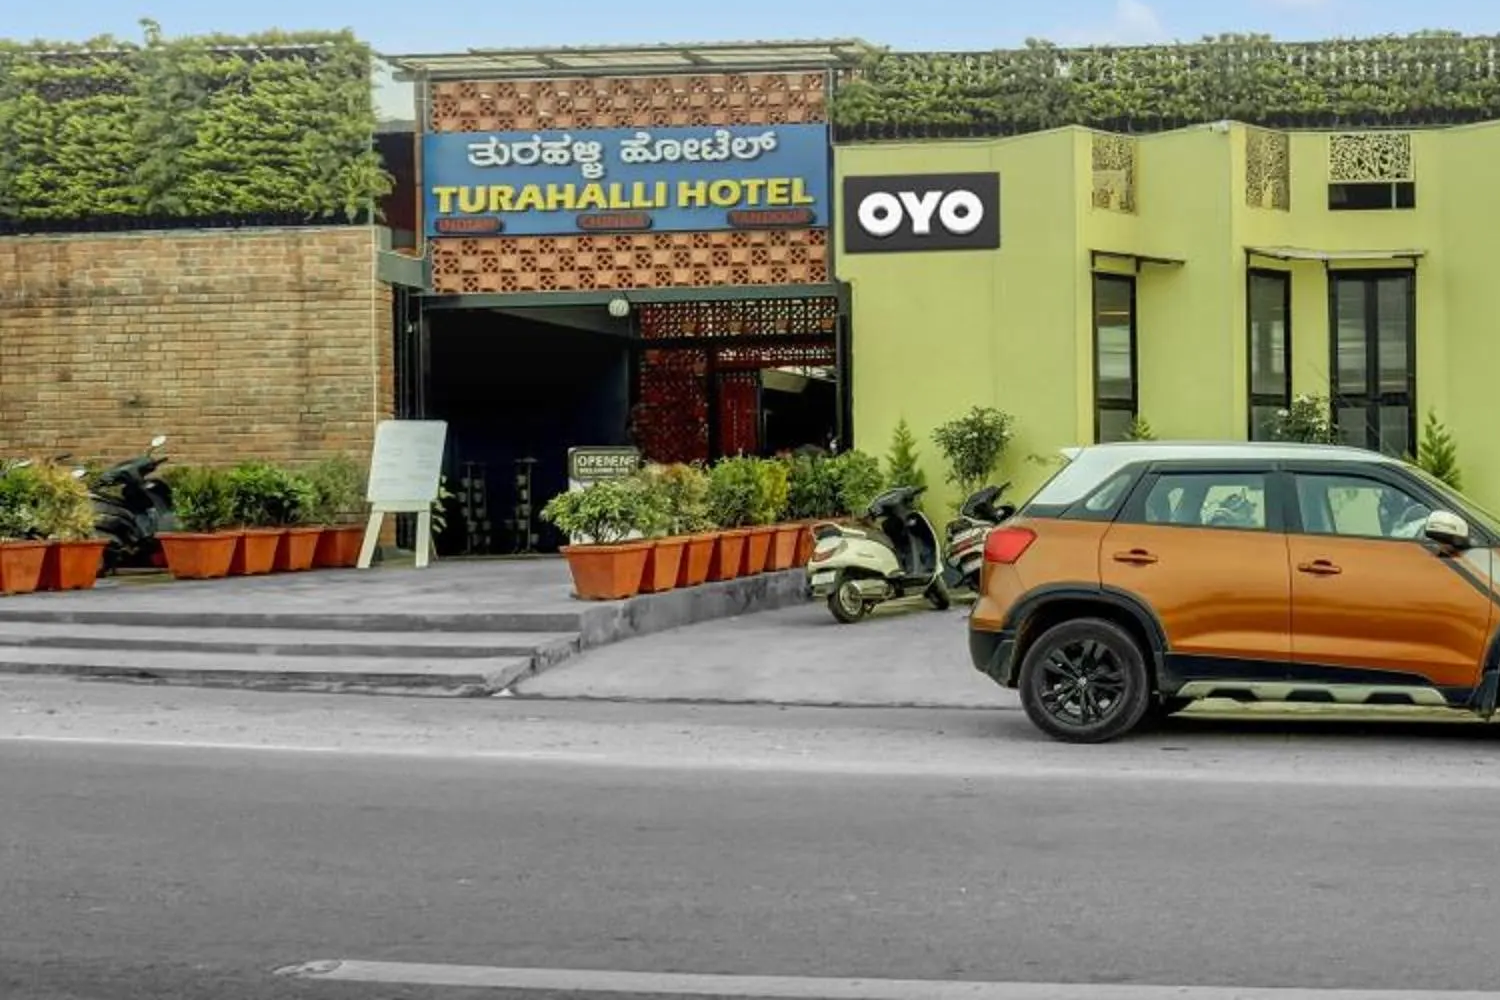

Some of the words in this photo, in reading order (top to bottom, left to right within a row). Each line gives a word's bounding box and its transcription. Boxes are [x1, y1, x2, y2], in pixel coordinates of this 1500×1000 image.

[620, 129, 777, 164] ಹೋಟೆಲ್
[432, 181, 668, 214] TURAHALLI
[676, 177, 815, 208] HOTEL
[858, 189, 984, 237] OYO
